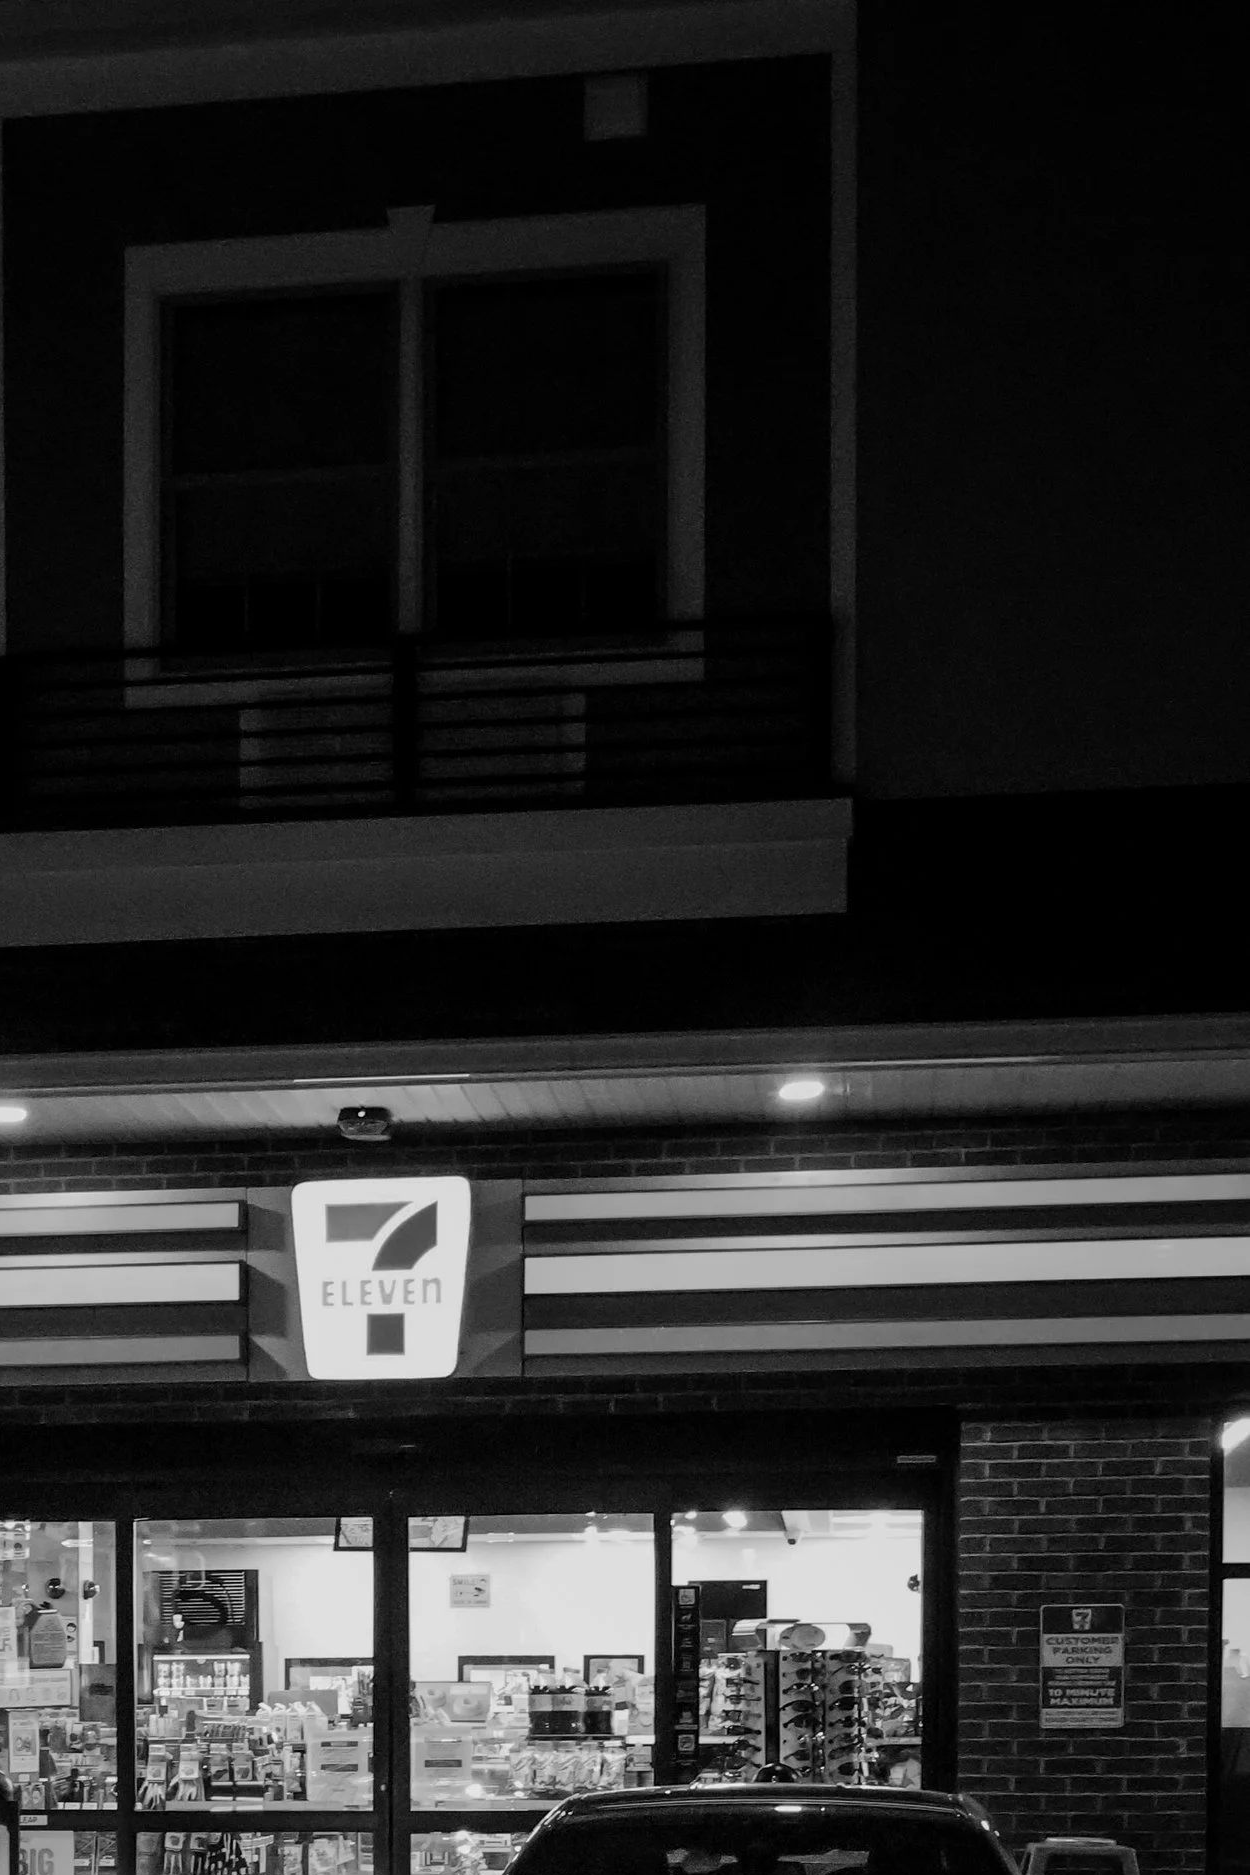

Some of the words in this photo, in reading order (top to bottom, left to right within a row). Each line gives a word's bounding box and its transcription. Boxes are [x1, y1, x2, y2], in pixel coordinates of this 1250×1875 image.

[1046, 1636, 1119, 1645] CUSTOMER
[1052, 1646, 1113, 1655] PARKING
[1065, 1656, 1100, 1664] ONLY
[1048, 1688, 1063, 1697] 10
[1066, 1688, 1116, 1697] MINUTE
[1050, 1697, 1114, 1706] MAXIMUM
